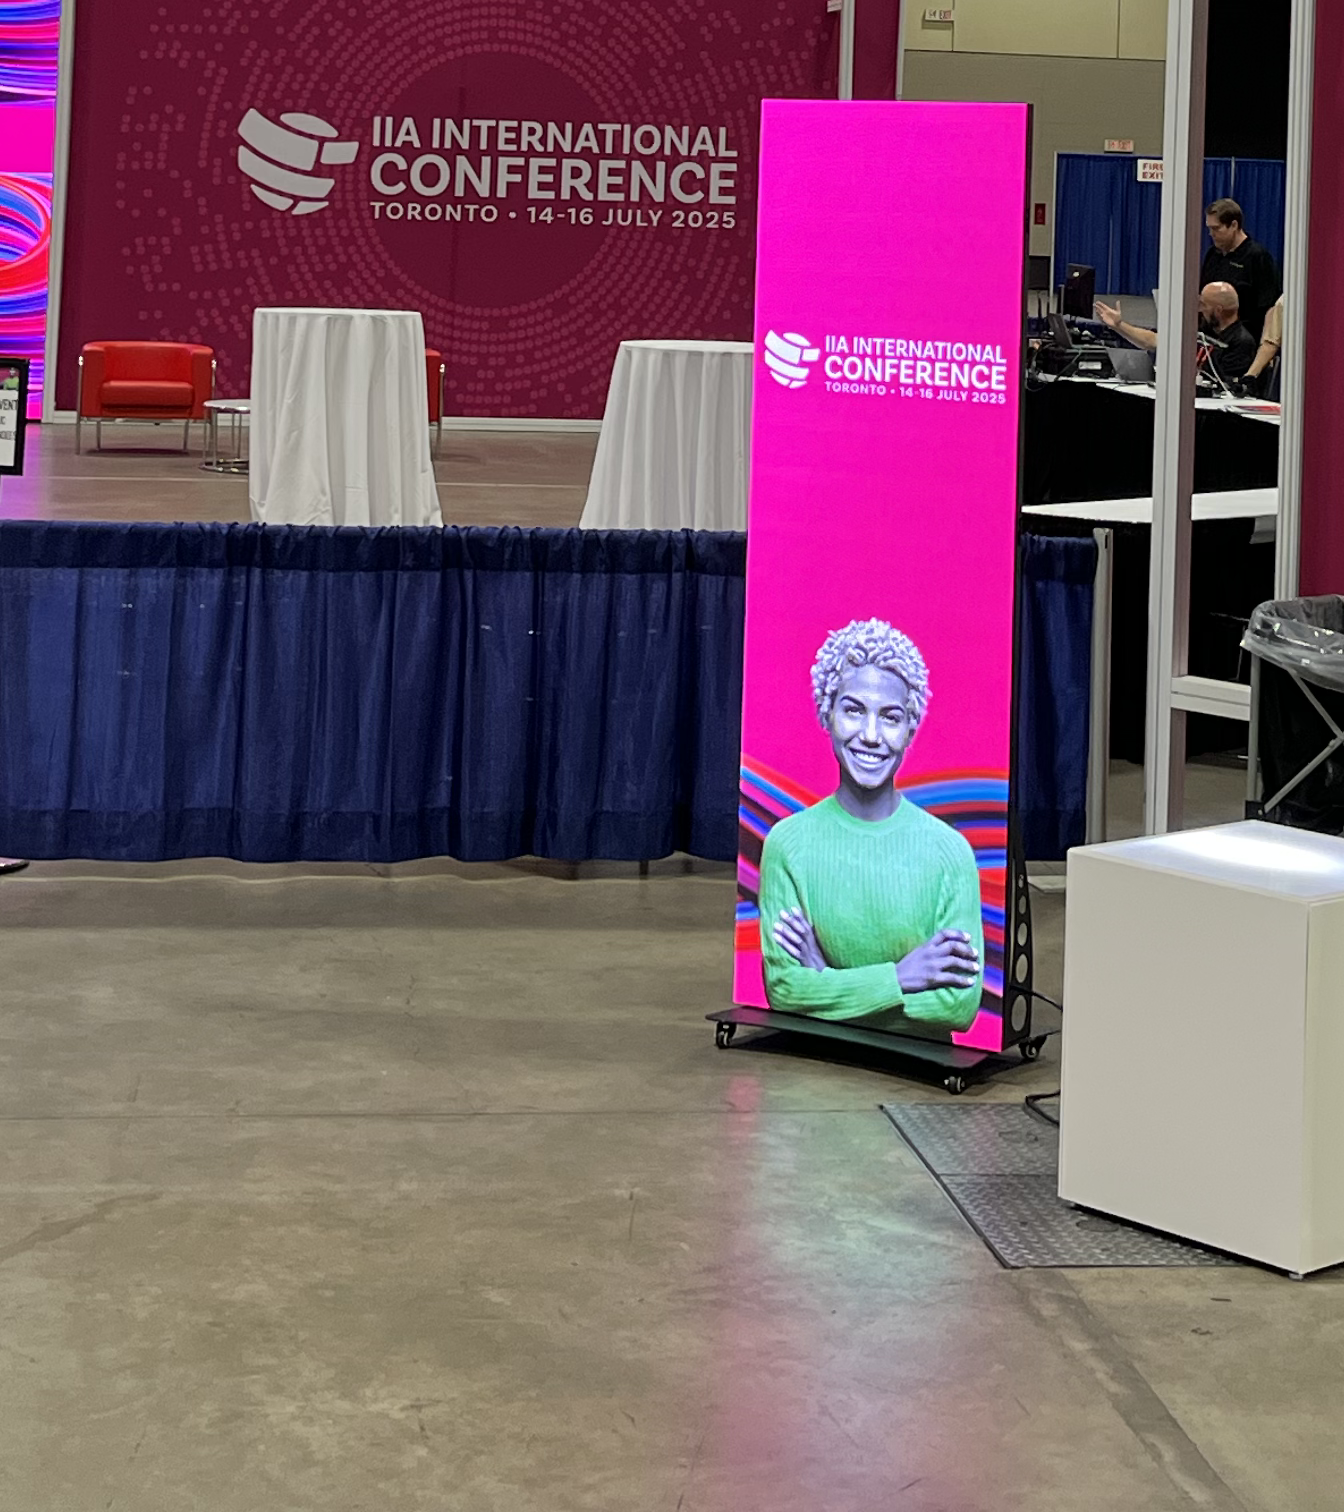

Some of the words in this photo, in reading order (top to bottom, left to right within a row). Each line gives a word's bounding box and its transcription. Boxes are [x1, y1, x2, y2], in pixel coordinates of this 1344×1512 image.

[372, 116, 421, 148] IIA
[432, 118, 738, 157] INTERNATIONAL
[370, 152, 738, 205] CONFERENCE
[1142, 172, 1163, 180] EXIT
[370, 201, 498, 223] TORONTO
[527, 206, 594, 225] 14-16
[602, 209, 662, 227] JULY
[671, 210, 736, 229] 2025
[825, 335, 849, 353] IIA
[853, 336, 1007, 364] INTERNATIONAL
[824, 355, 1007, 390] CONFERENCE
[825, 381, 887, 396] TORONTO
[899, 386, 934, 399] 14-16
[936, 389, 968, 402] JULY
[972, 392, 1006, 404] 2025
